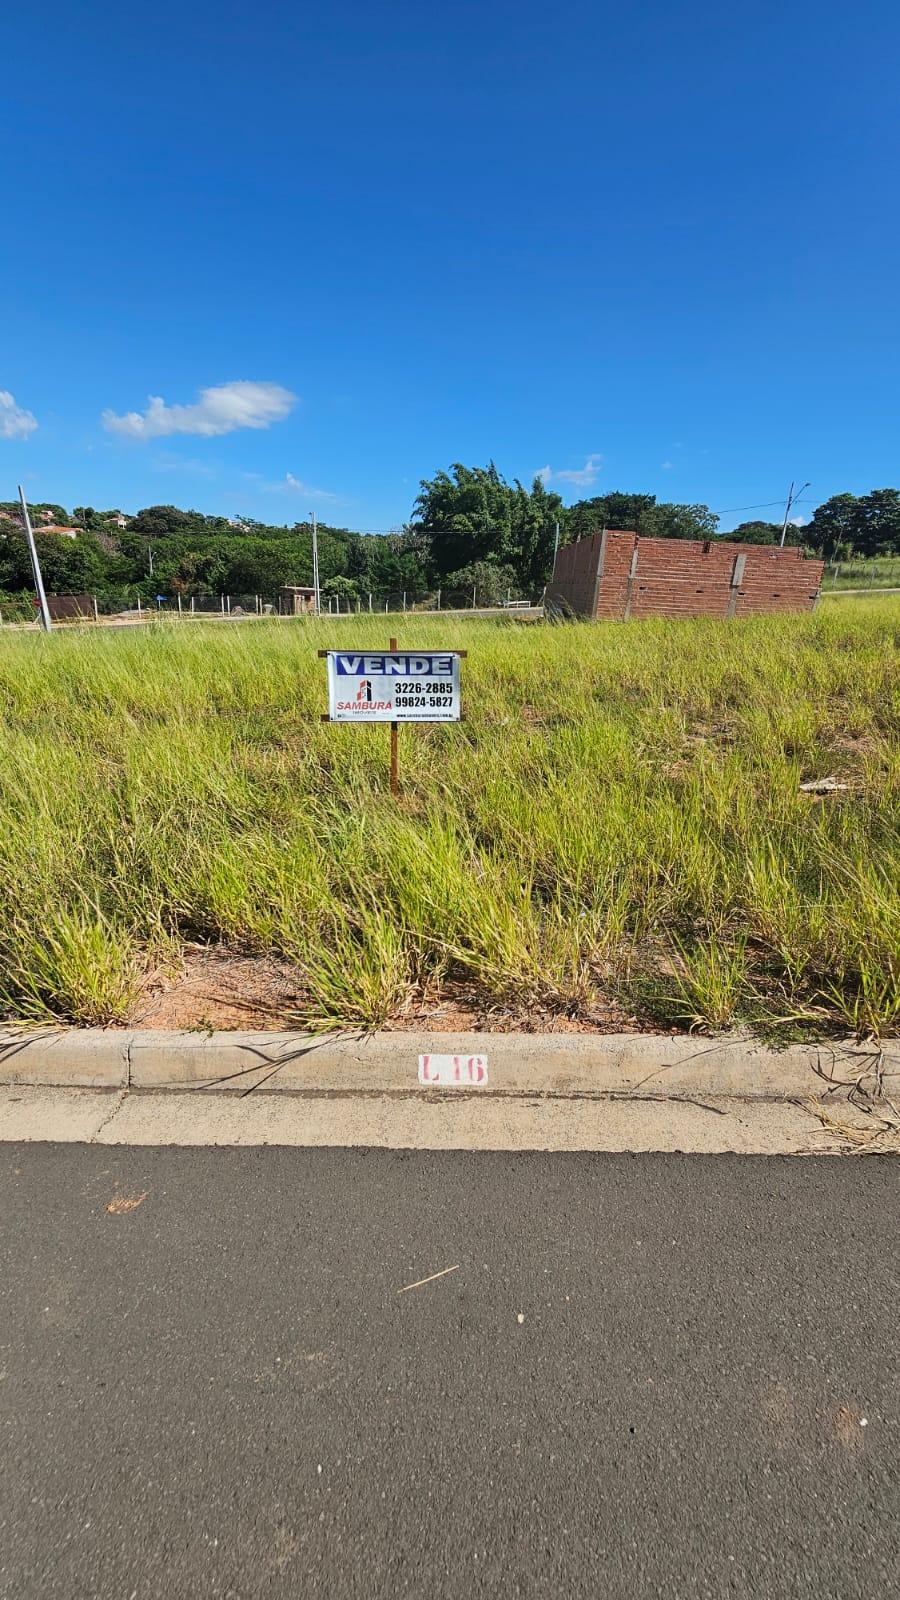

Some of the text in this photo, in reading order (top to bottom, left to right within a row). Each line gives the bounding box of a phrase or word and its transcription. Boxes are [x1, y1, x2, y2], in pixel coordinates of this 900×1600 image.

[340, 657, 451, 674] VENDE
[395, 682, 453, 693] 3226-2885
[395, 696, 453, 707] 99824-5827
[423, 1055, 484, 1081] L 16
